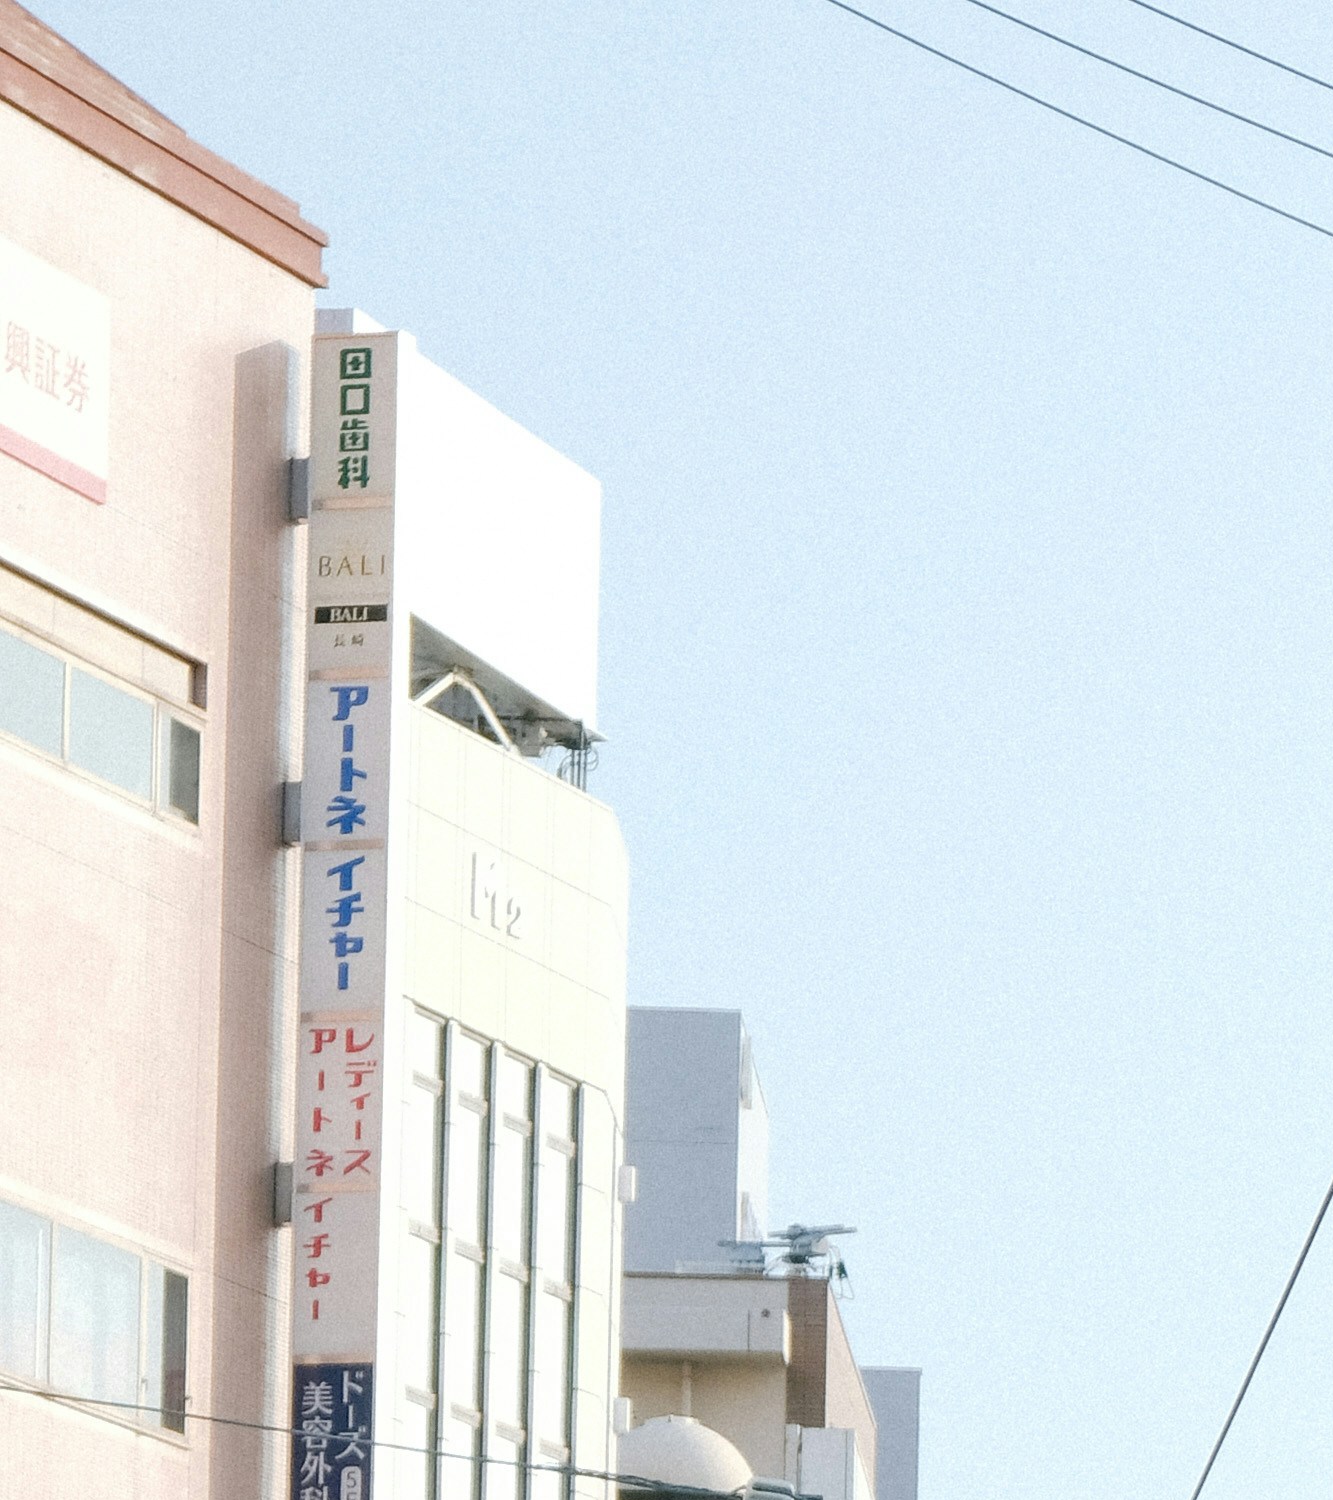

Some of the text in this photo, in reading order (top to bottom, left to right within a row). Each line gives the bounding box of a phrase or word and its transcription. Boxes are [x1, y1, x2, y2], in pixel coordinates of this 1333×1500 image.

[338, 347, 372, 489] 田口歯科
[318, 554, 386, 577] BALI
[329, 605, 370, 622] BALI
[326, 686, 370, 990] アートネイチャー
[343, 1027, 377, 1176] レディース
[303, 1028, 338, 1320] アートネイチャー
[335, 1370, 365, 1460] ドーズ
